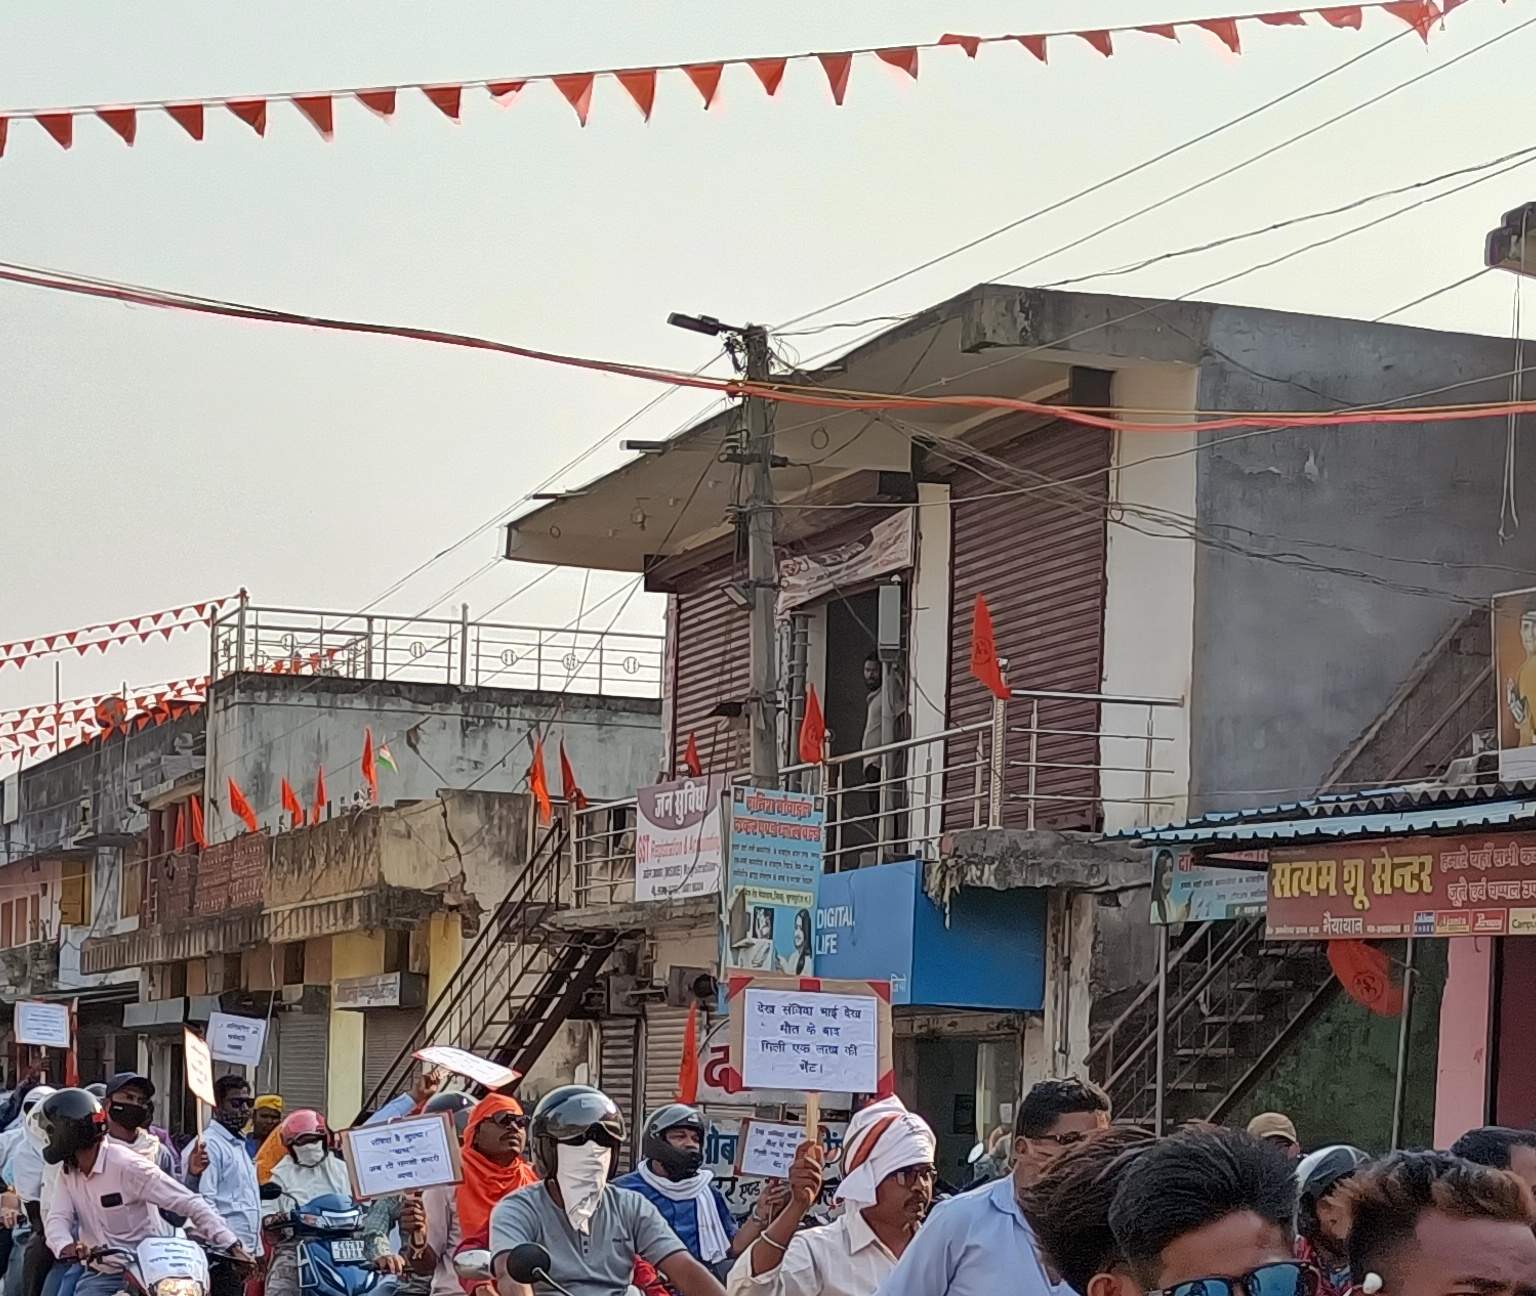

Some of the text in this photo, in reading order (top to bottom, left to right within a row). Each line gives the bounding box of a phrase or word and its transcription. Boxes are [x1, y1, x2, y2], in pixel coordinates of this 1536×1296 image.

[655, 781, 708, 826] जन सुविधा
[1493, 841, 1519, 867] सभी
[1271, 859, 1336, 899] सत्यम
[1342, 858, 1371, 910] शू
[1371, 847, 1434, 895] सेन्टर
[816, 933, 837, 955] LIFE
[792, 1043, 810, 1054] एक
